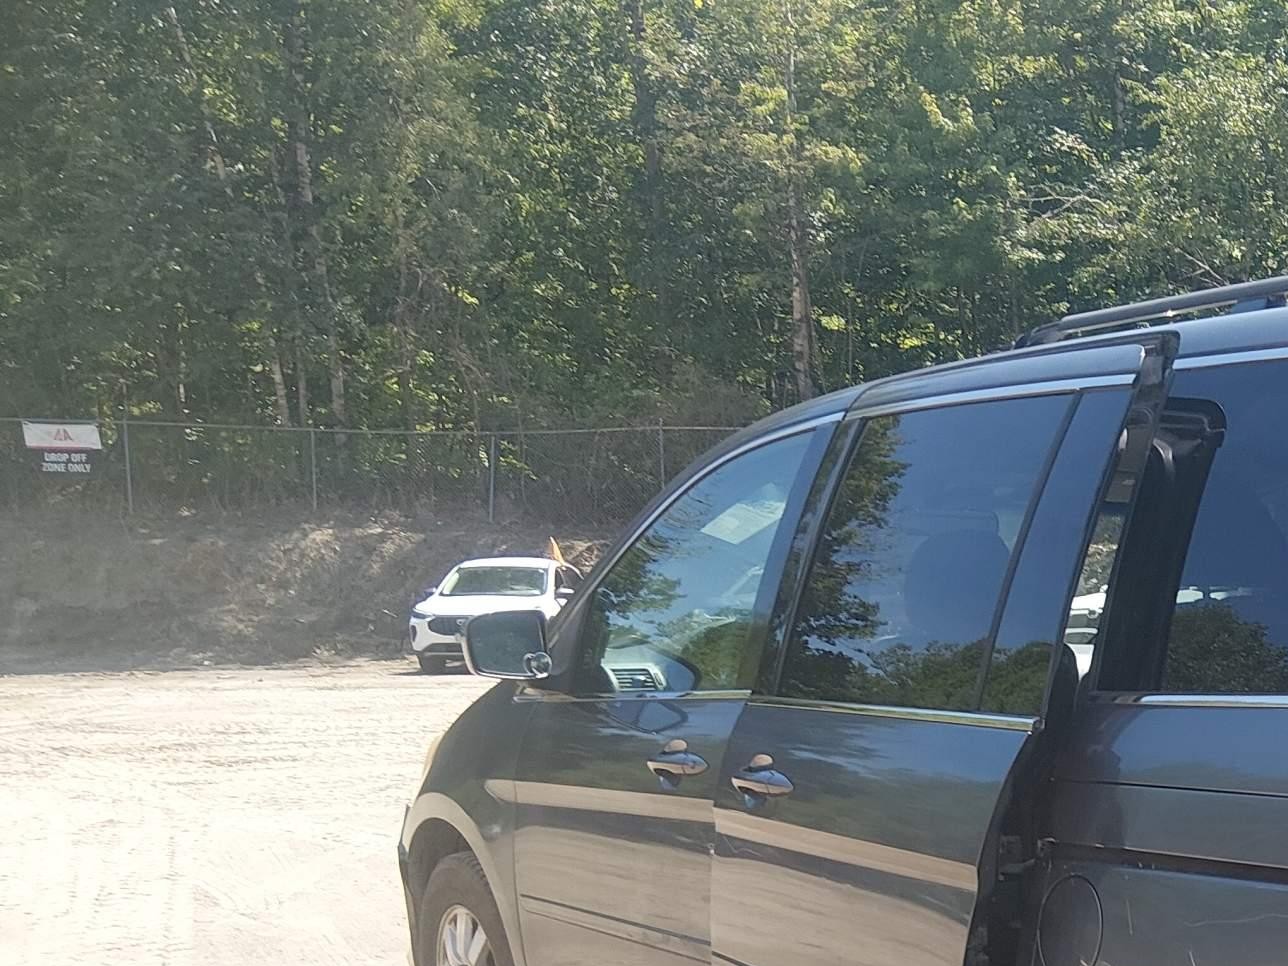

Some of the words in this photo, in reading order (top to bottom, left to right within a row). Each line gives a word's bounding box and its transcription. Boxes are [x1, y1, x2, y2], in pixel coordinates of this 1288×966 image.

[45, 453, 69, 462] DROP
[71, 453, 87, 462] OFF
[43, 463, 66, 472] ZONE
[69, 464, 91, 473] ONLY
